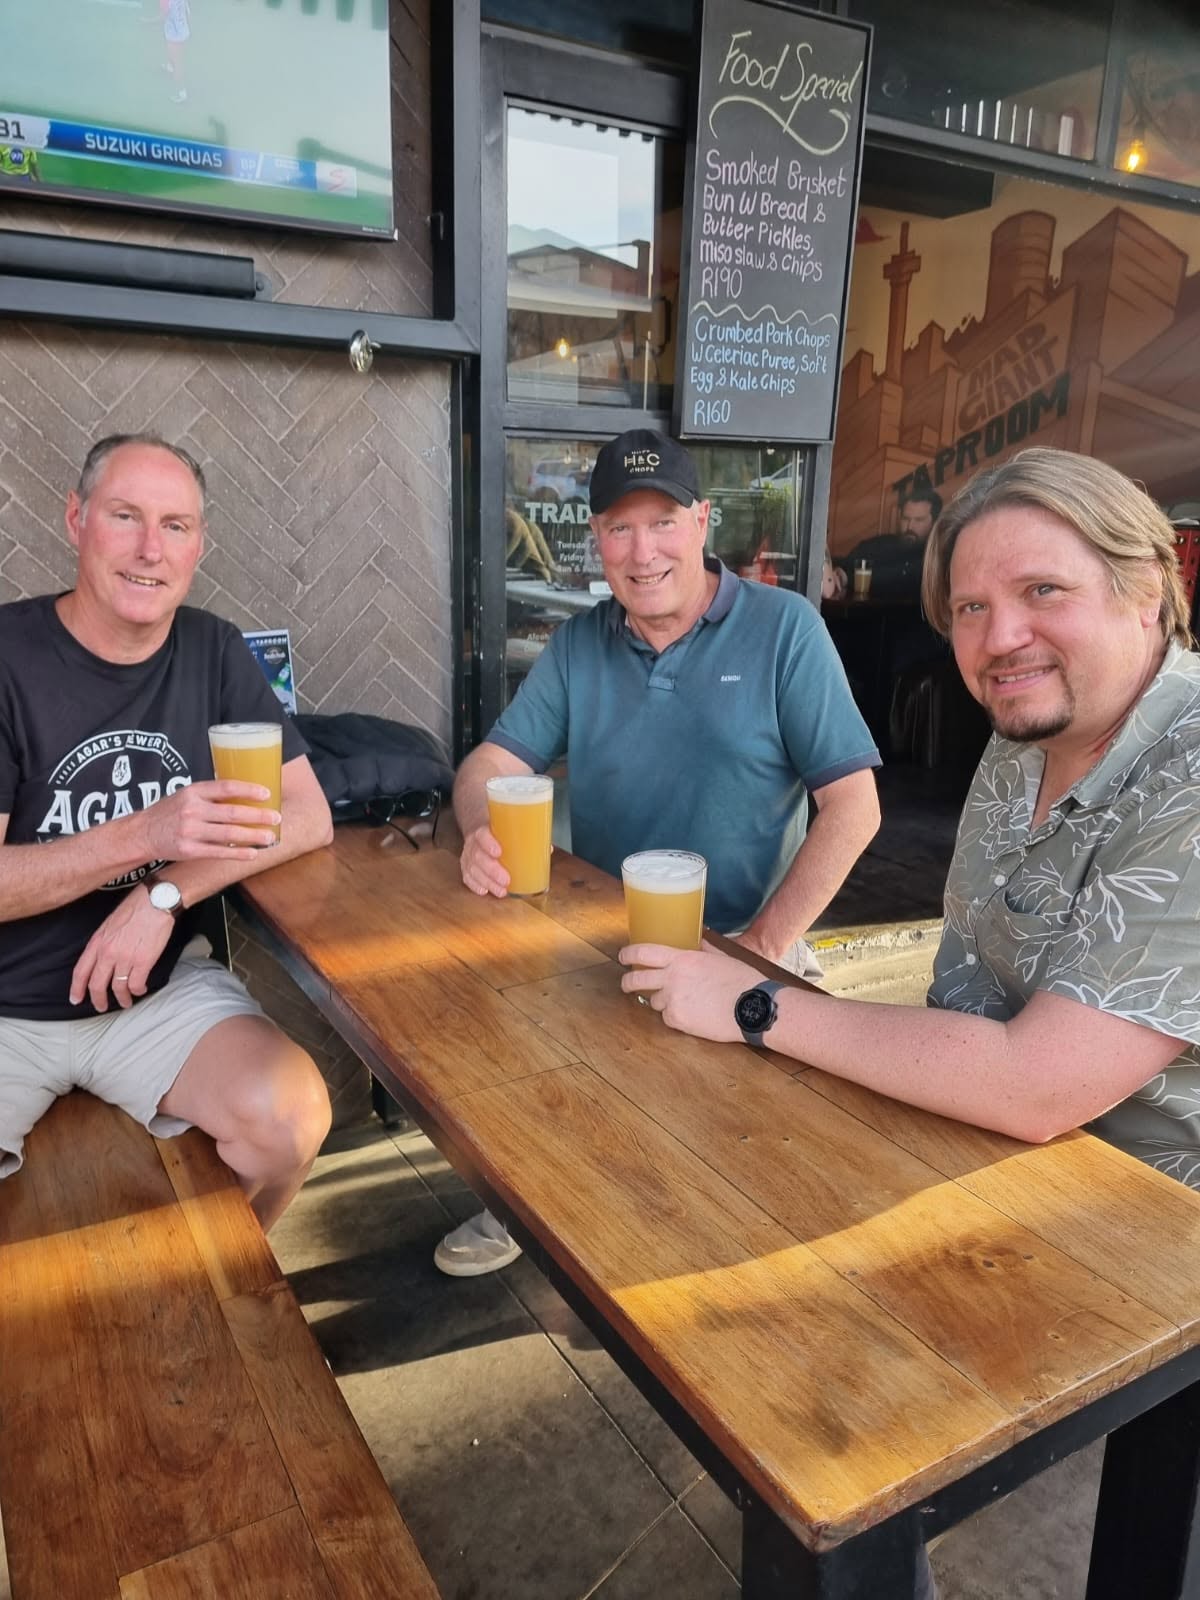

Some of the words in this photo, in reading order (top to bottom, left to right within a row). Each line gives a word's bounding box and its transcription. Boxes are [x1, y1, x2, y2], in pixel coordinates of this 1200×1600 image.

[718, 30, 790, 91] Food
[780, 42, 864, 134] Special
[84, 132, 148, 157] SUZUKI
[151, 142, 223, 168] GRIQUAS
[705, 149, 780, 187] Smoked
[786, 159, 848, 198] Brisket
[703, 183, 735, 214] Bun
[760, 192, 809, 224] Bread
[812, 202, 827, 223] &
[702, 211, 755, 242] Butter
[766, 251, 779, 272] &
[700, 265, 743, 299] R190
[694, 315, 764, 345] Crumbed
[765, 320, 793, 347] Pork
[794, 326, 831, 355] Chops
[704, 343, 760, 368] Celeriac
[761, 348, 801, 376] Puree,
[800, 354, 828, 375] Soft
[690, 366, 714, 395] Egg
[729, 367, 759, 392] Kale
[760, 373, 796, 399] Chips
[693, 399, 732, 426] R160
[892, 371, 1071, 500] TAPROOM
[524, 502, 592, 524] TRAD
[75, 735, 122, 763] AGAR'S
